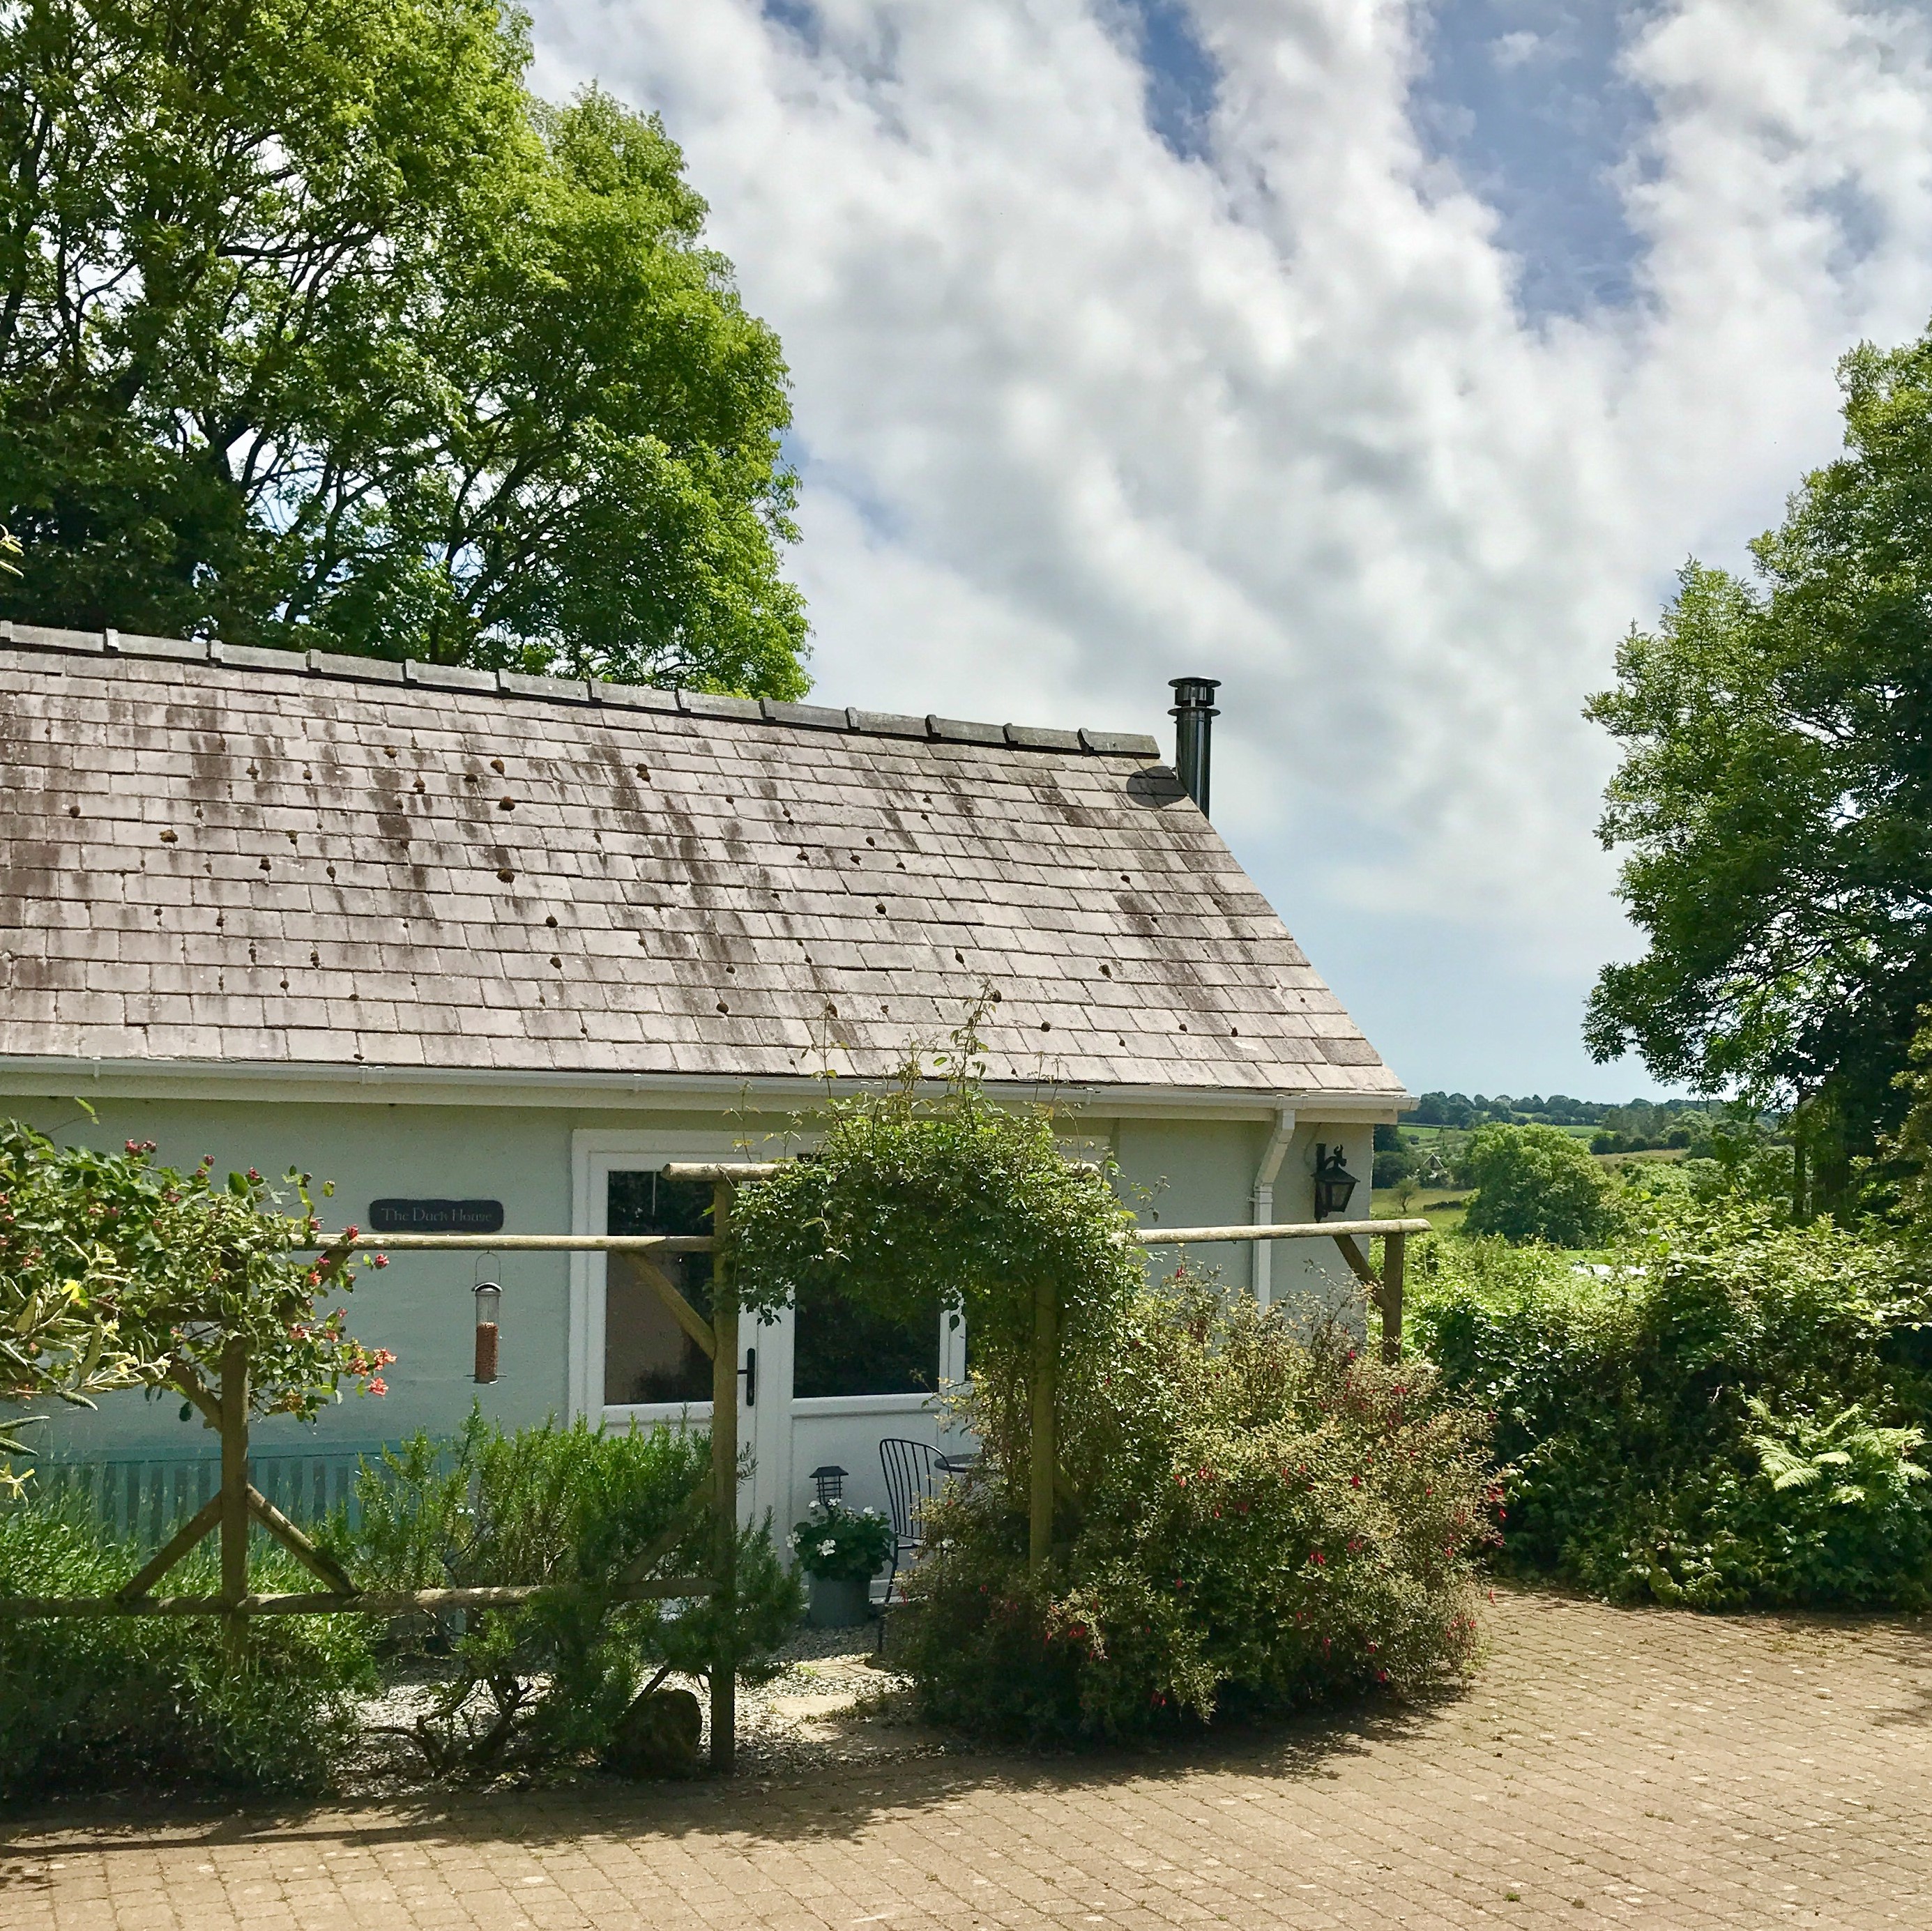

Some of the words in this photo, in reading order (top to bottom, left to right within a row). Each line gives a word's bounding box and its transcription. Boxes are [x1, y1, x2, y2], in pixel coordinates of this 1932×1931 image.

[381, 1207, 409, 1221] The
[413, 1207, 447, 1222] Duck
[452, 1208, 492, 1222] House
